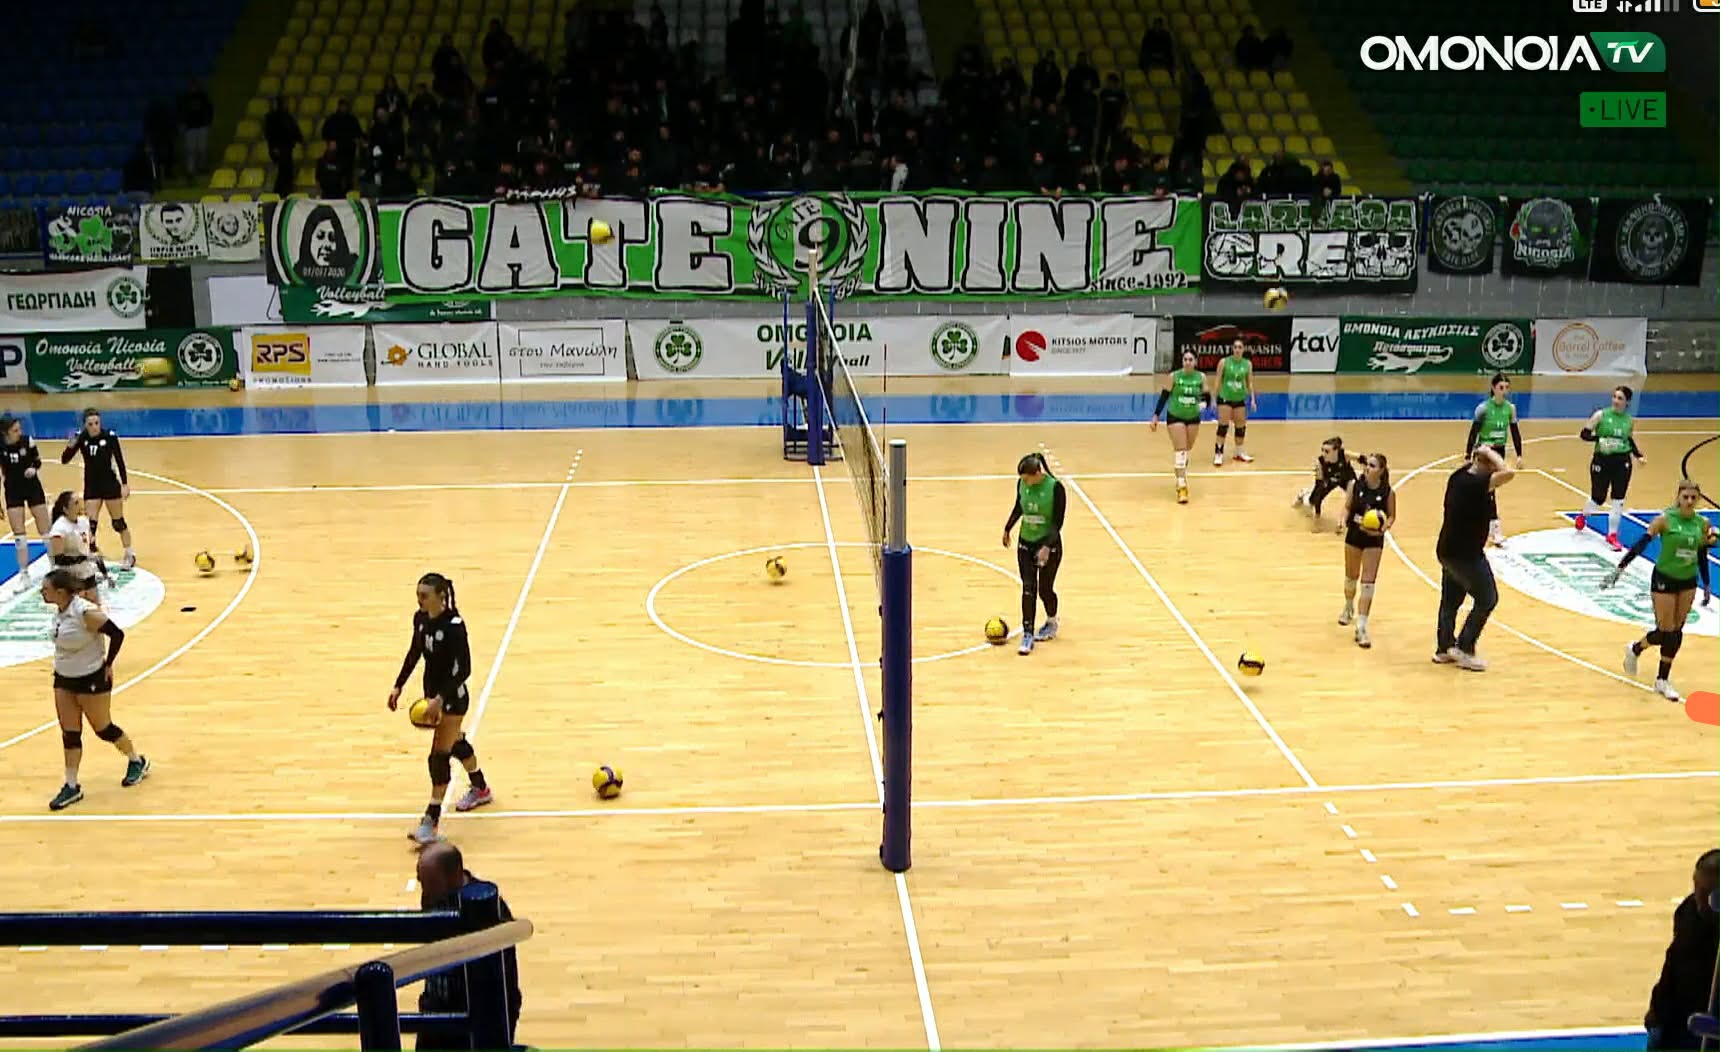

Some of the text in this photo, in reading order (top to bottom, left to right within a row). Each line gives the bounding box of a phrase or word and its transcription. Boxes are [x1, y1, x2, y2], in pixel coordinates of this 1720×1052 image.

[400, 197, 1177, 294] GATE NINE
[7, 291, 97, 311] ΓΕΩΡΓΙΑΔΗ
[36, 336, 166, 356] Omonoia Nicosia
[417, 342, 493, 359] GLOBAL
[1051, 336, 1128, 347] KITSIOS MOTORS
[256, 343, 306, 363] RPS
[417, 361, 449, 369] HAND
